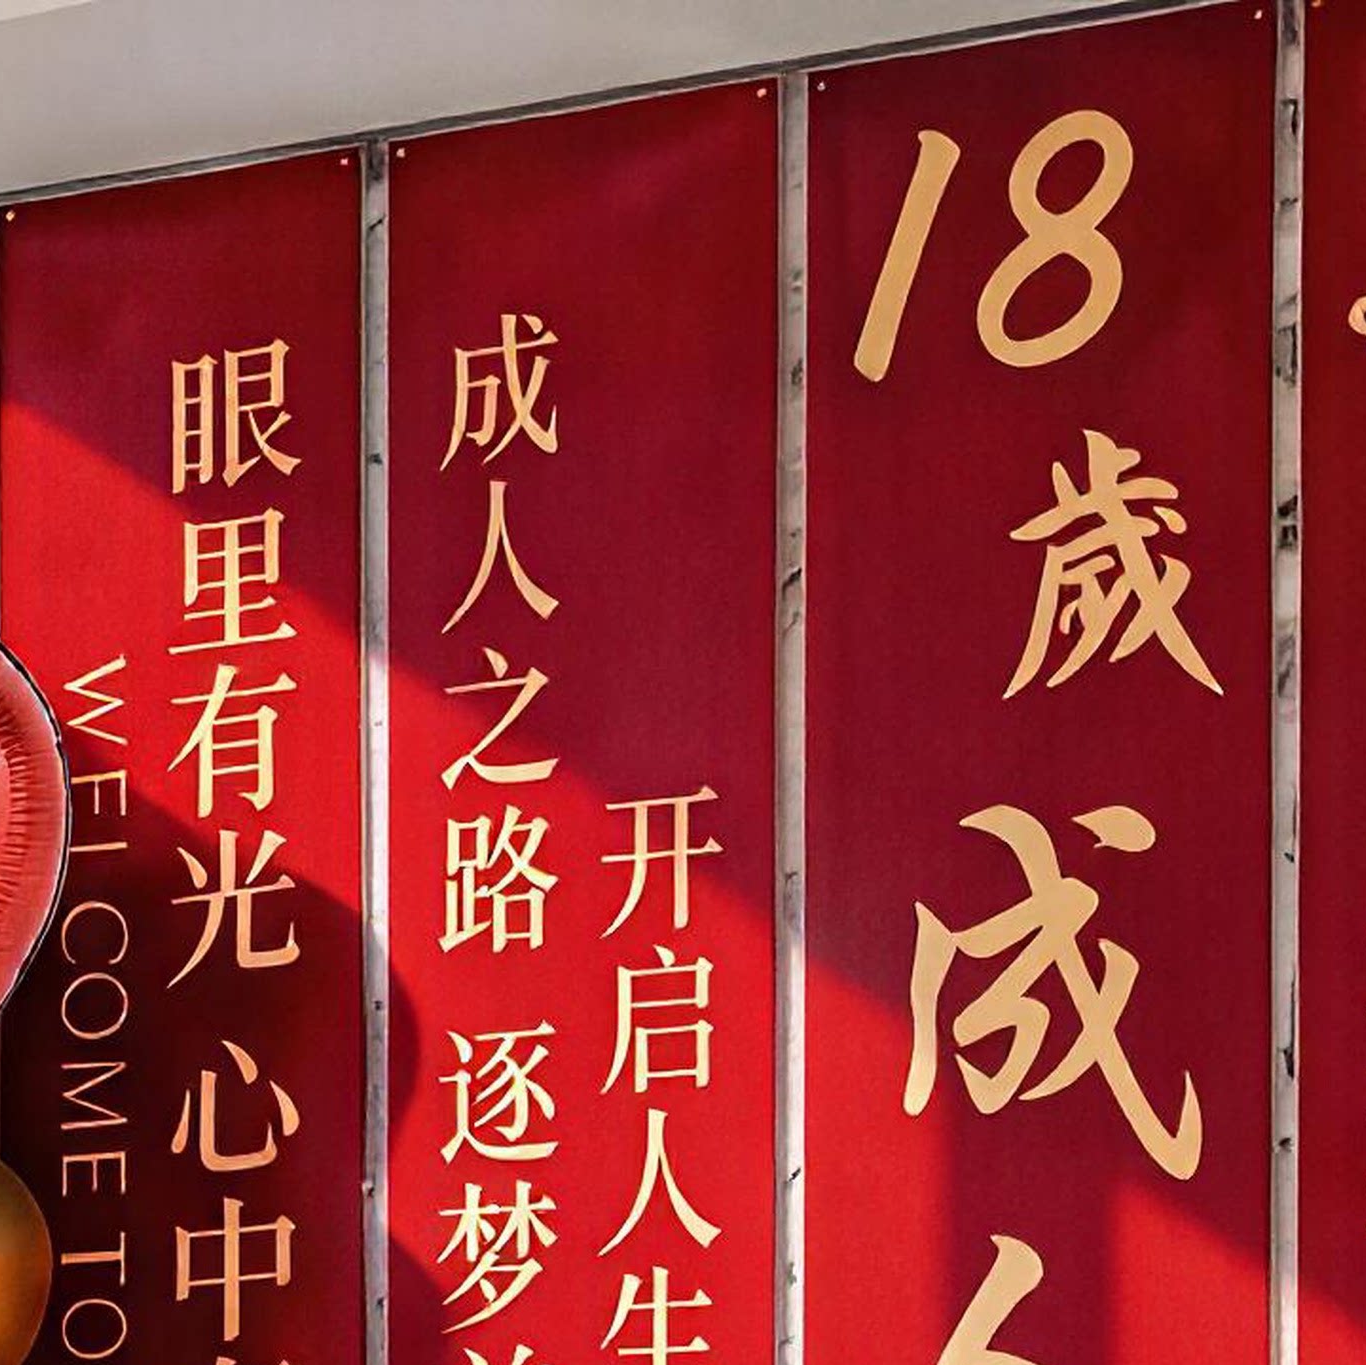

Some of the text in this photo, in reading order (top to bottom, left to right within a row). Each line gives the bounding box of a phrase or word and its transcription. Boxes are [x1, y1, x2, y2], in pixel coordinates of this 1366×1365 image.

[166, 338, 302, 989] 眼里有光
[438, 313, 559, 953] 成人之路
[61, 1231, 127, 1359] TO
